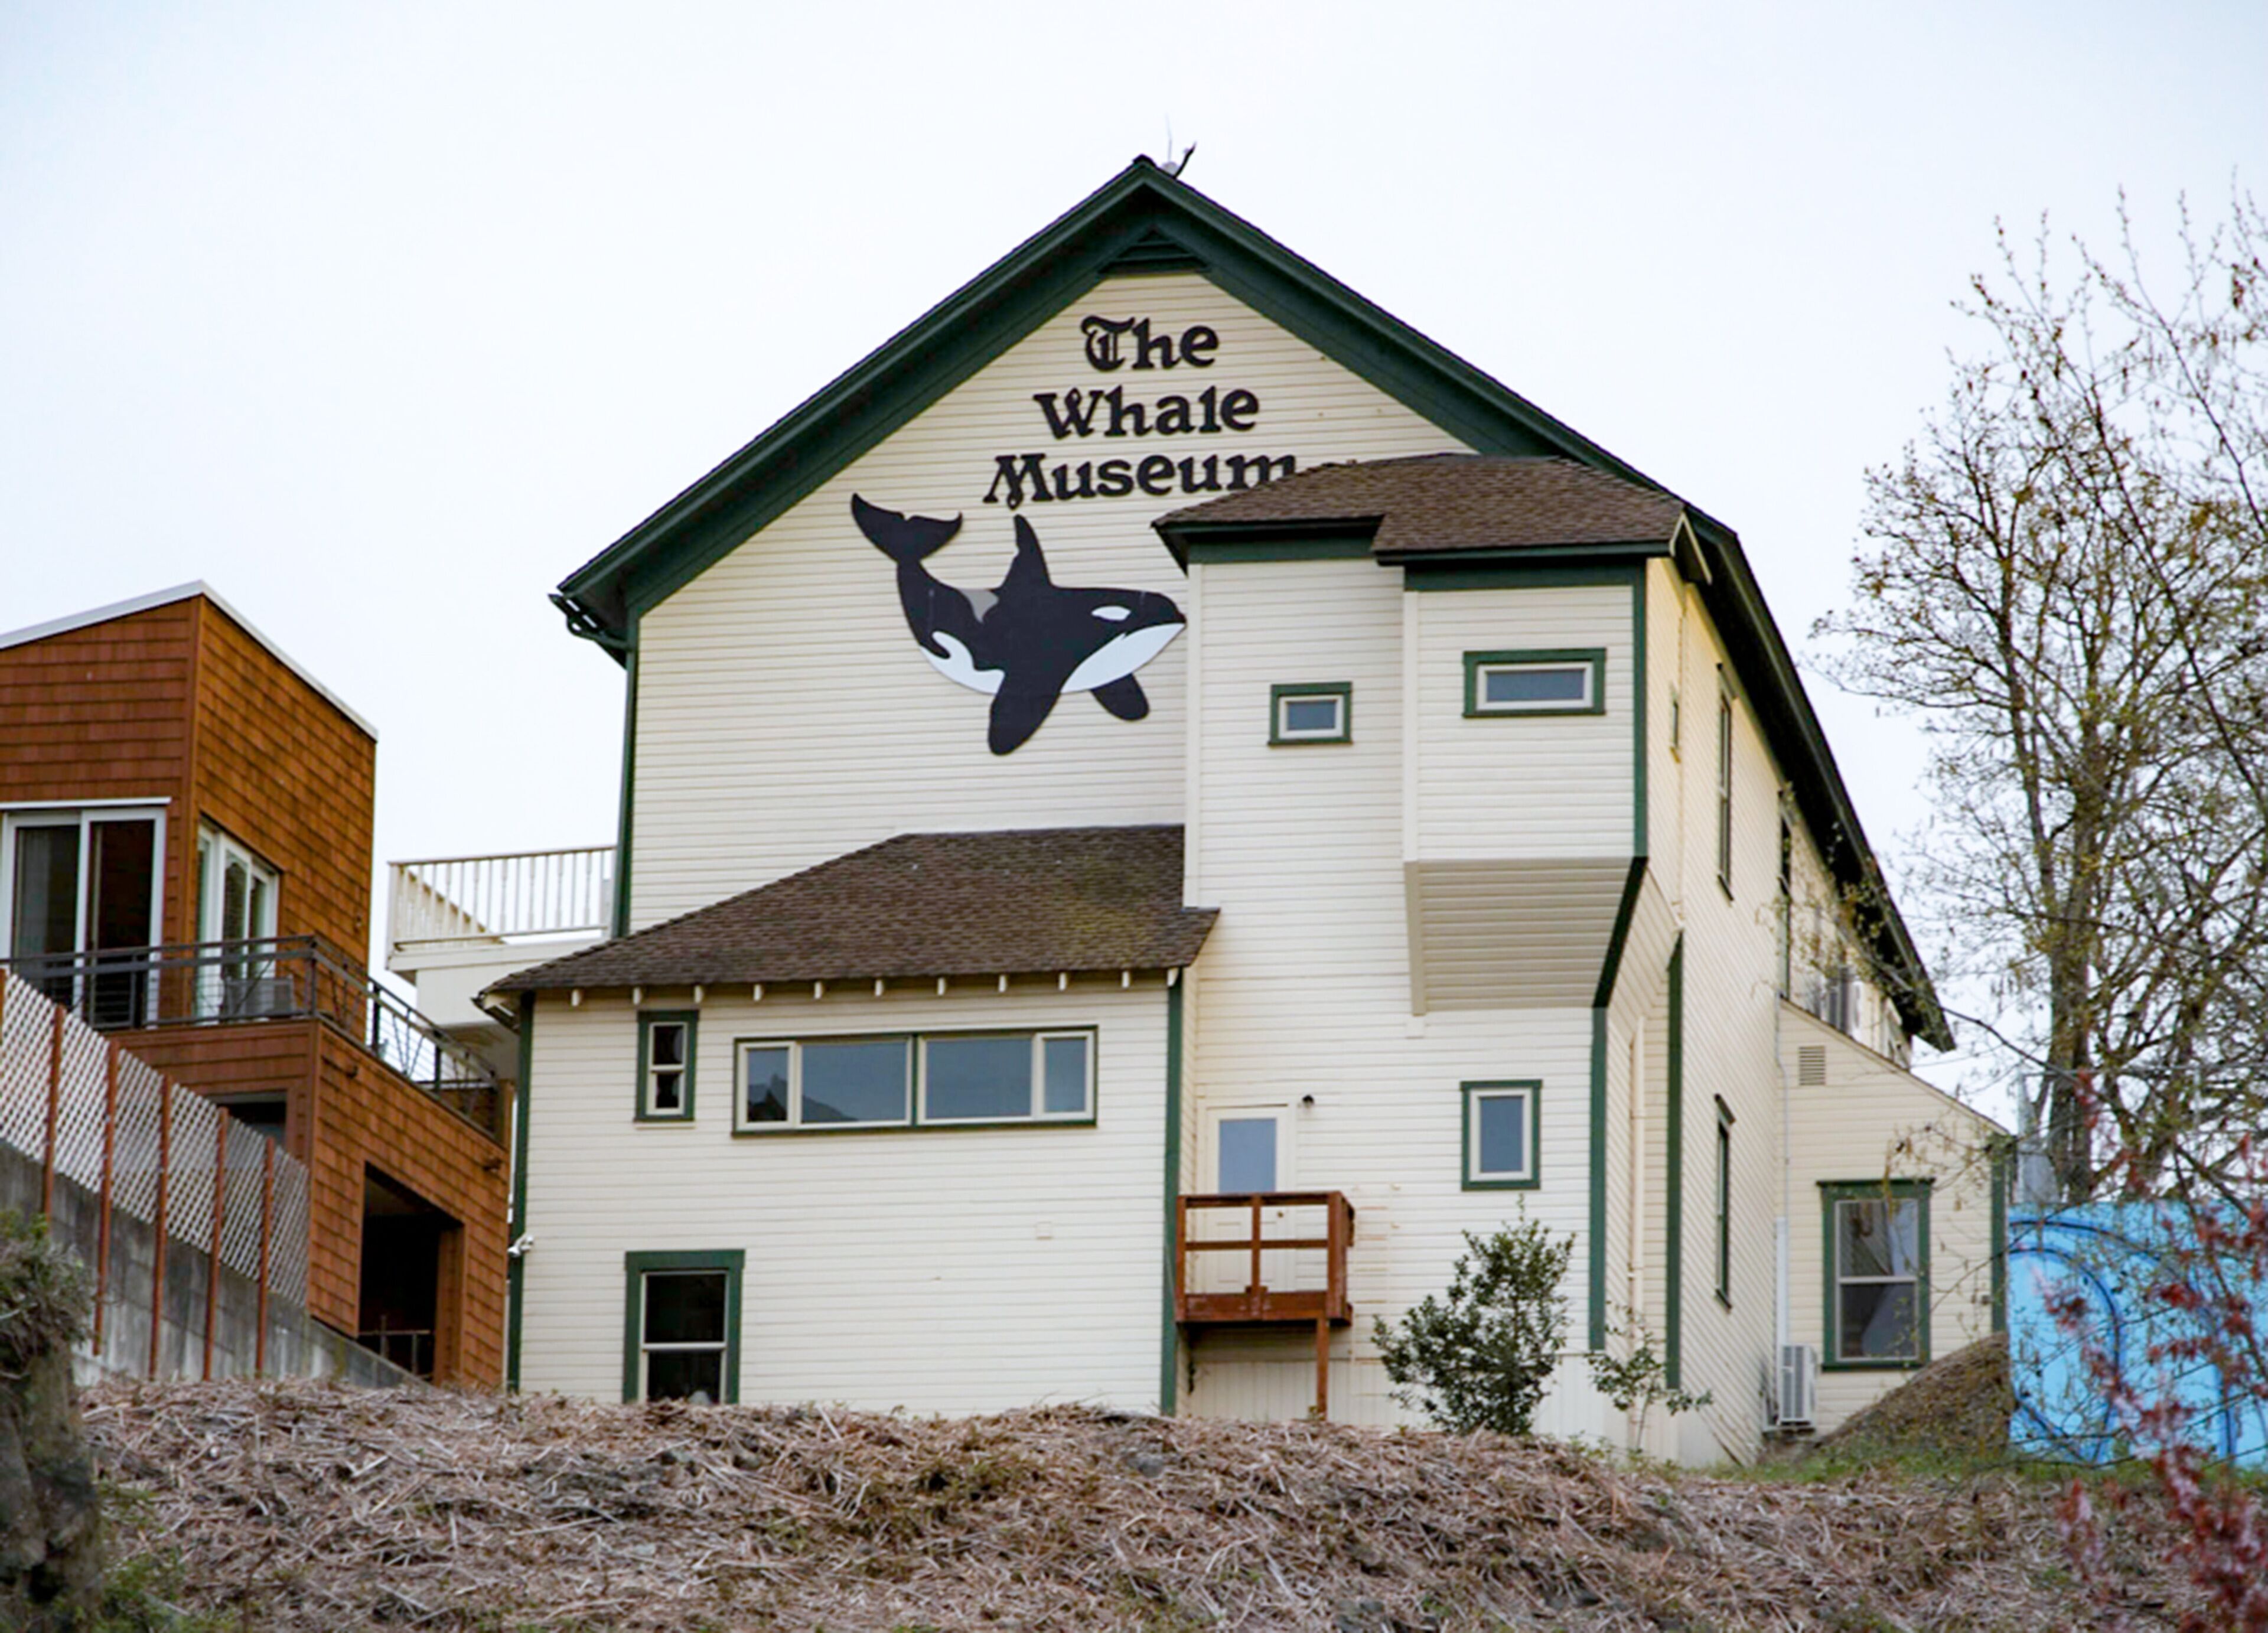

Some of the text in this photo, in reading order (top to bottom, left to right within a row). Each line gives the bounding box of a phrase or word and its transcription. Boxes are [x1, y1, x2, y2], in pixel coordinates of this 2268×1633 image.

[1080, 315, 1220, 373] The
[1032, 384, 1259, 439] Whale
[982, 452, 1296, 511] Museum
